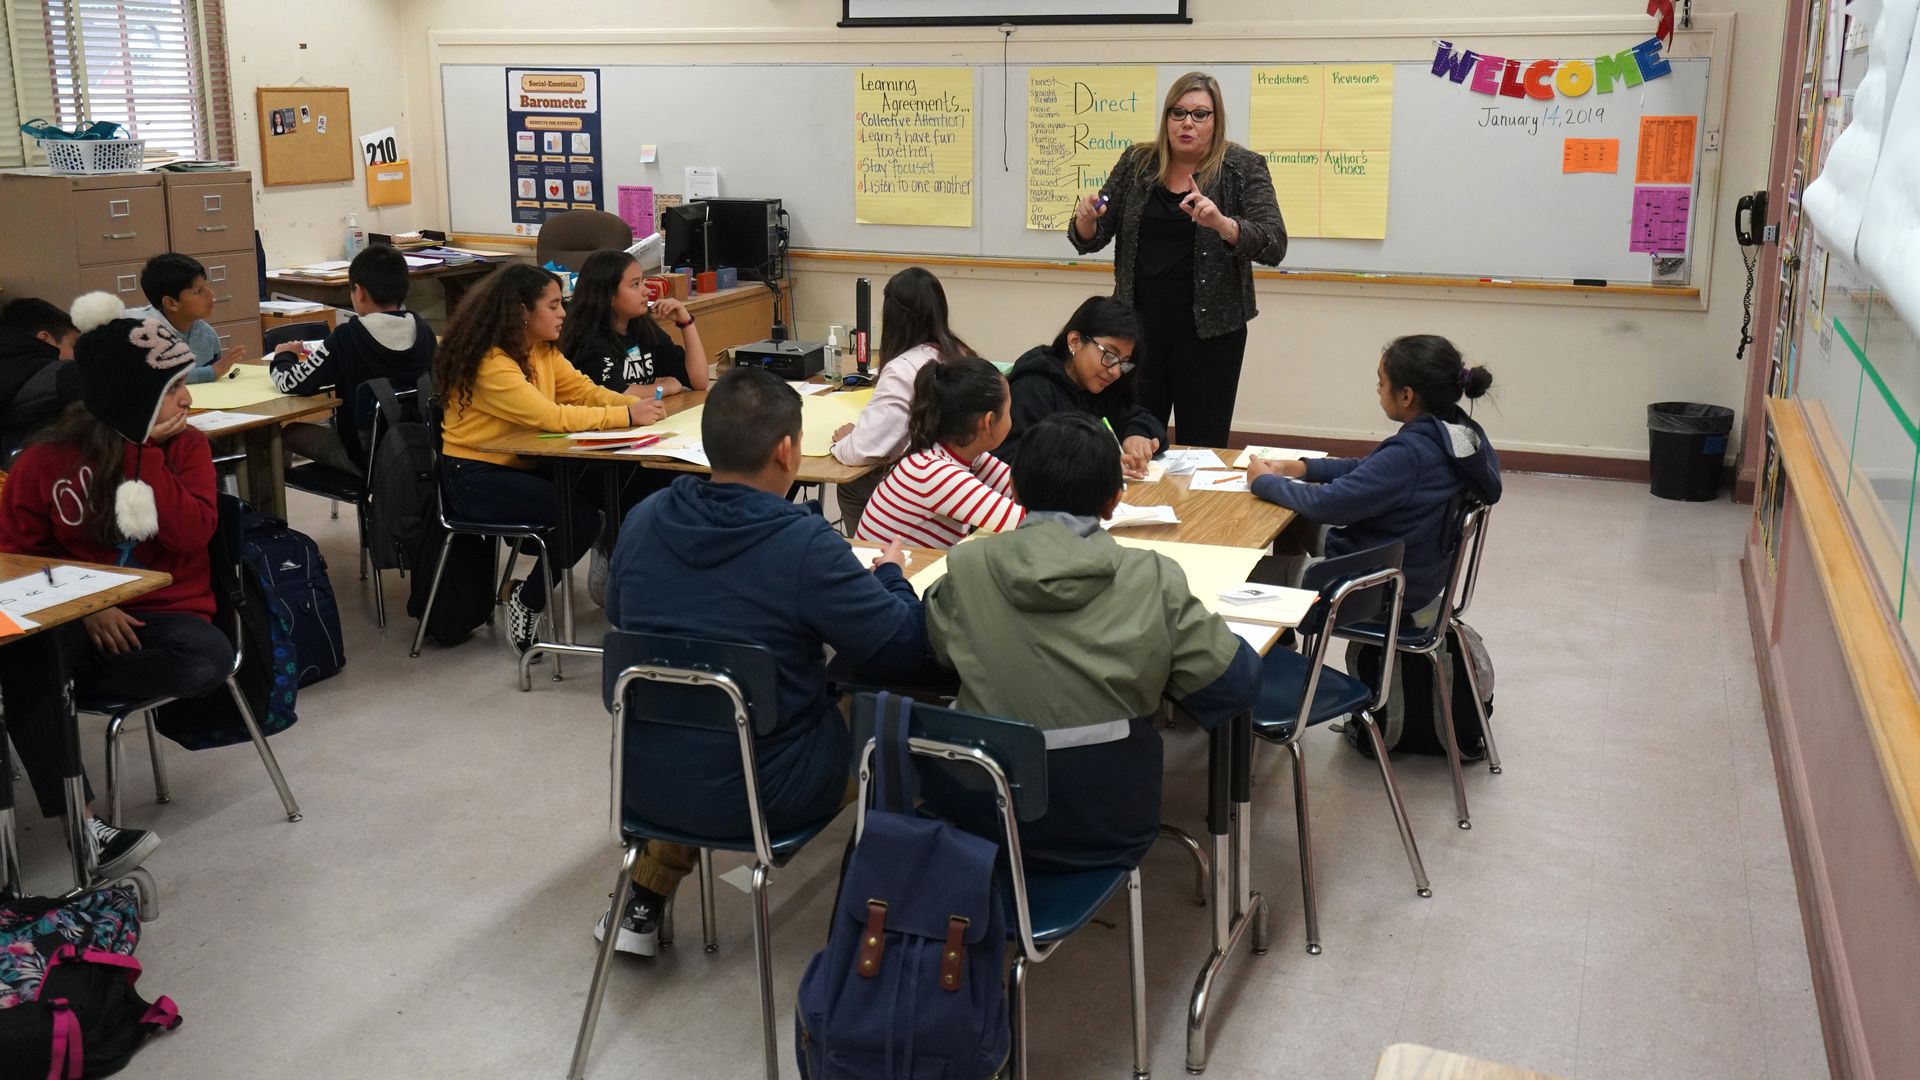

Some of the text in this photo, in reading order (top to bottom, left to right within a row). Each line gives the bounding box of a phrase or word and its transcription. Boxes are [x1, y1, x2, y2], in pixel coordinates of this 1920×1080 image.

[1332, 71, 1380, 84] Revisions
[1431, 36, 1672, 101] WELCOME
[528, 80, 578, 88] Social-Emotional
[861, 73, 917, 96] Learning
[1257, 72, 1309, 85] Predictions
[519, 94, 588, 109] Barometer
[882, 91, 970, 116] Agreements...
[1074, 82, 1140, 115] Direct
[860, 111, 965, 128] Collective Attention
[1478, 107, 1539, 136] January
[1565, 107, 1605, 125] 2019
[861, 129, 893, 144] Learn
[905, 129, 933, 143] have
[933, 129, 956, 145] fun
[366, 136, 398, 166] 210
[876, 142, 930, 159] together
[863, 154, 935, 178] Stay focused
[1333, 163, 1366, 175] Choice
[863, 174, 972, 195] Listen to one another
